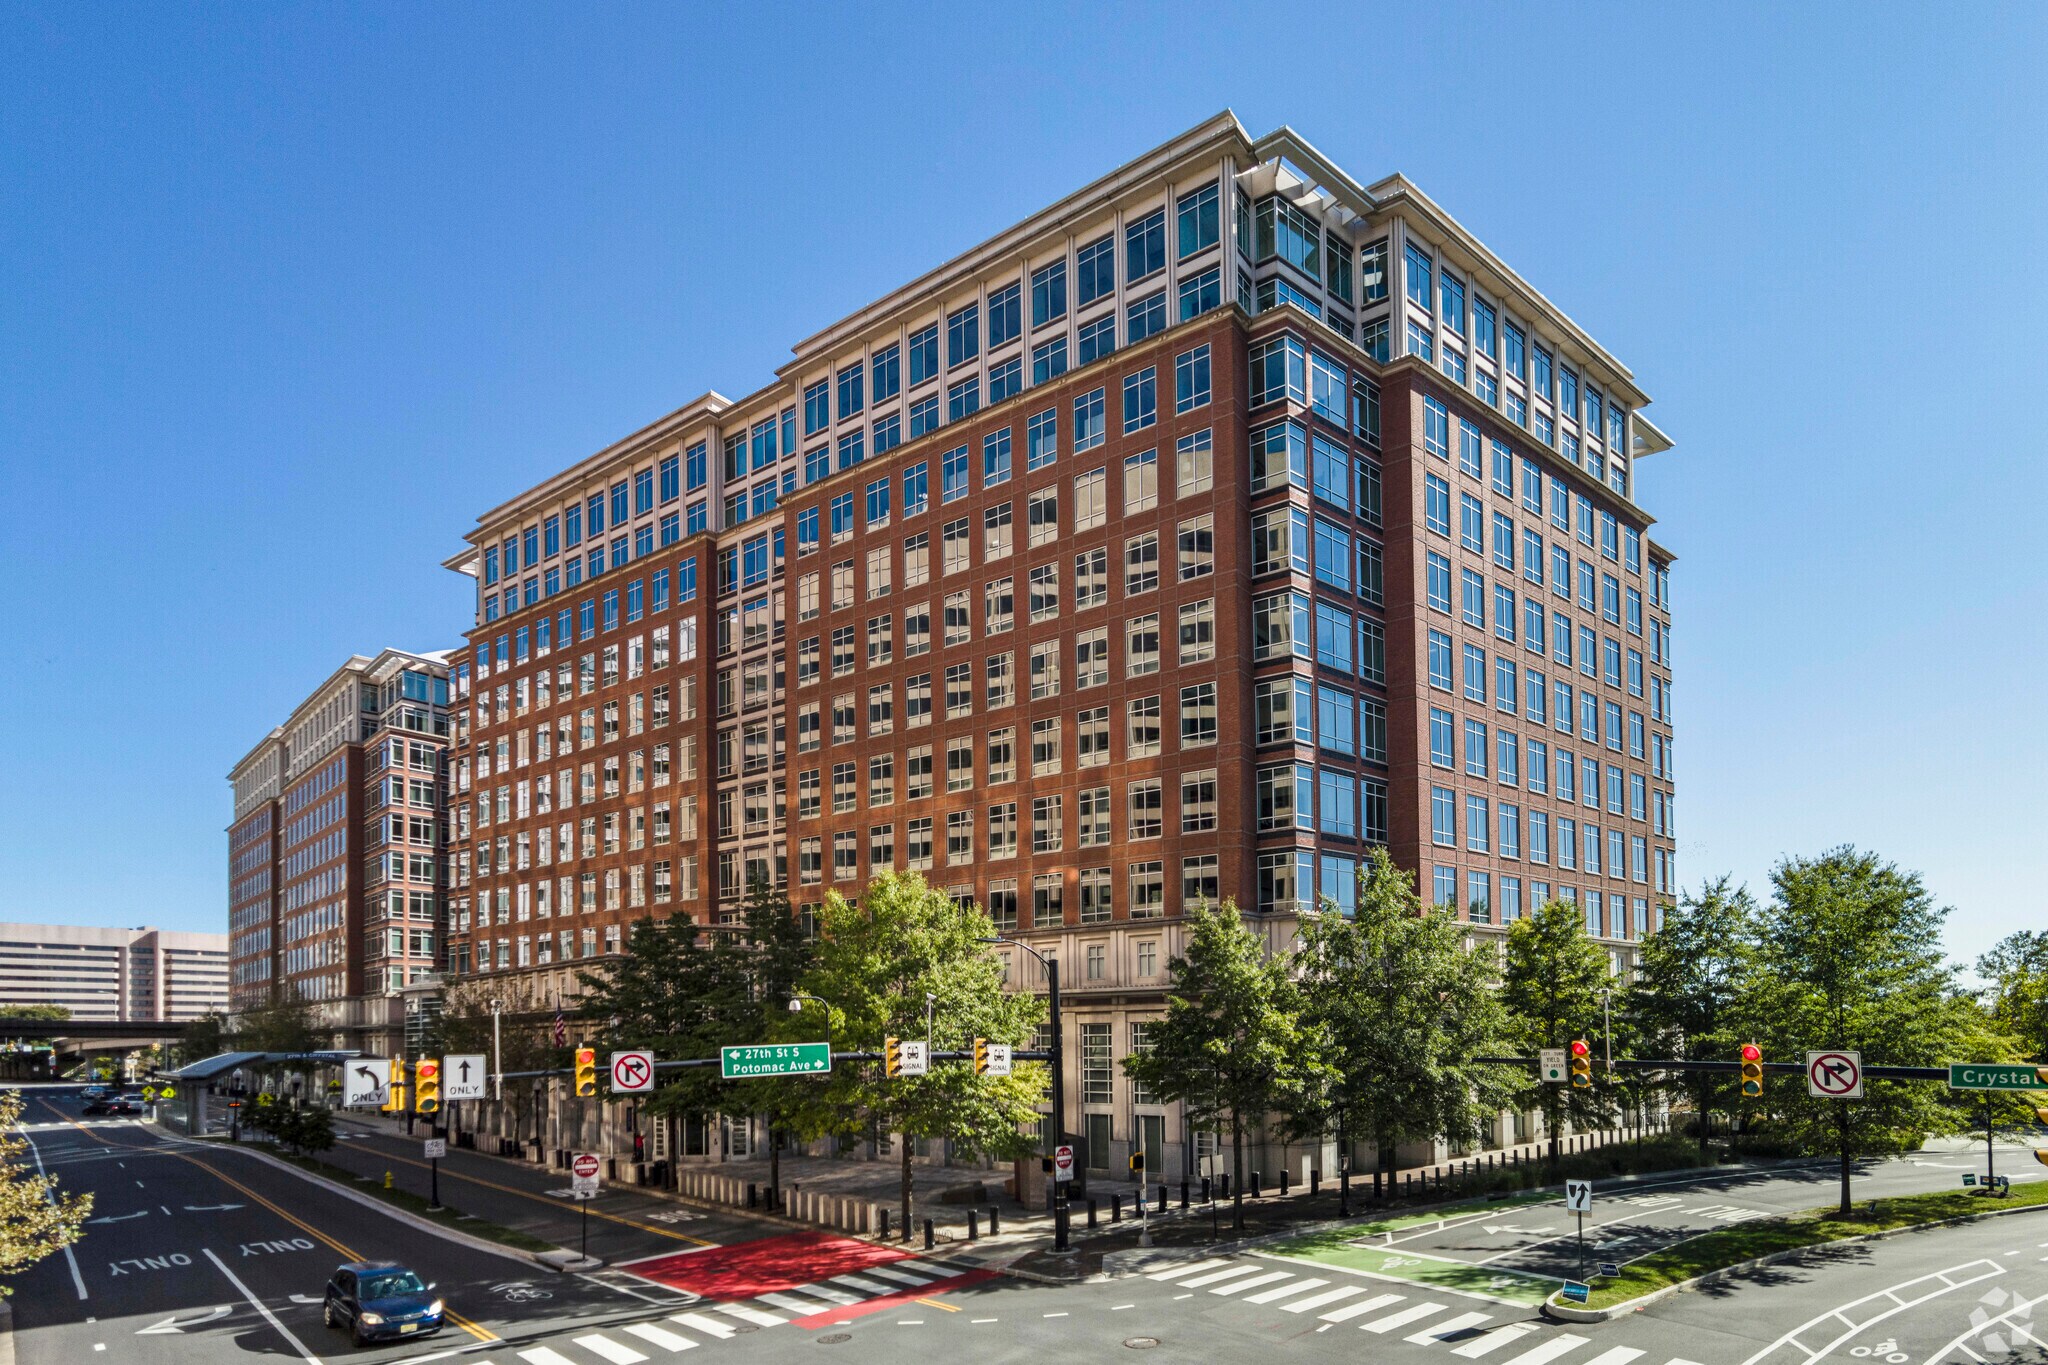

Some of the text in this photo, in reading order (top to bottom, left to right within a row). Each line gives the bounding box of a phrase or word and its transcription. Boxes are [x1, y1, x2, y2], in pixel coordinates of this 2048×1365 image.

[745, 1047, 800, 1059] 27th St S
[733, 1061, 811, 1074] Potomac Ave
[902, 1062, 924, 1070] SIGNAL
[449, 1085, 480, 1095] ONLY
[351, 1092, 383, 1103] ONLY
[240, 1238, 315, 1257] ONLY
[109, 1253, 192, 1276] ONLY
